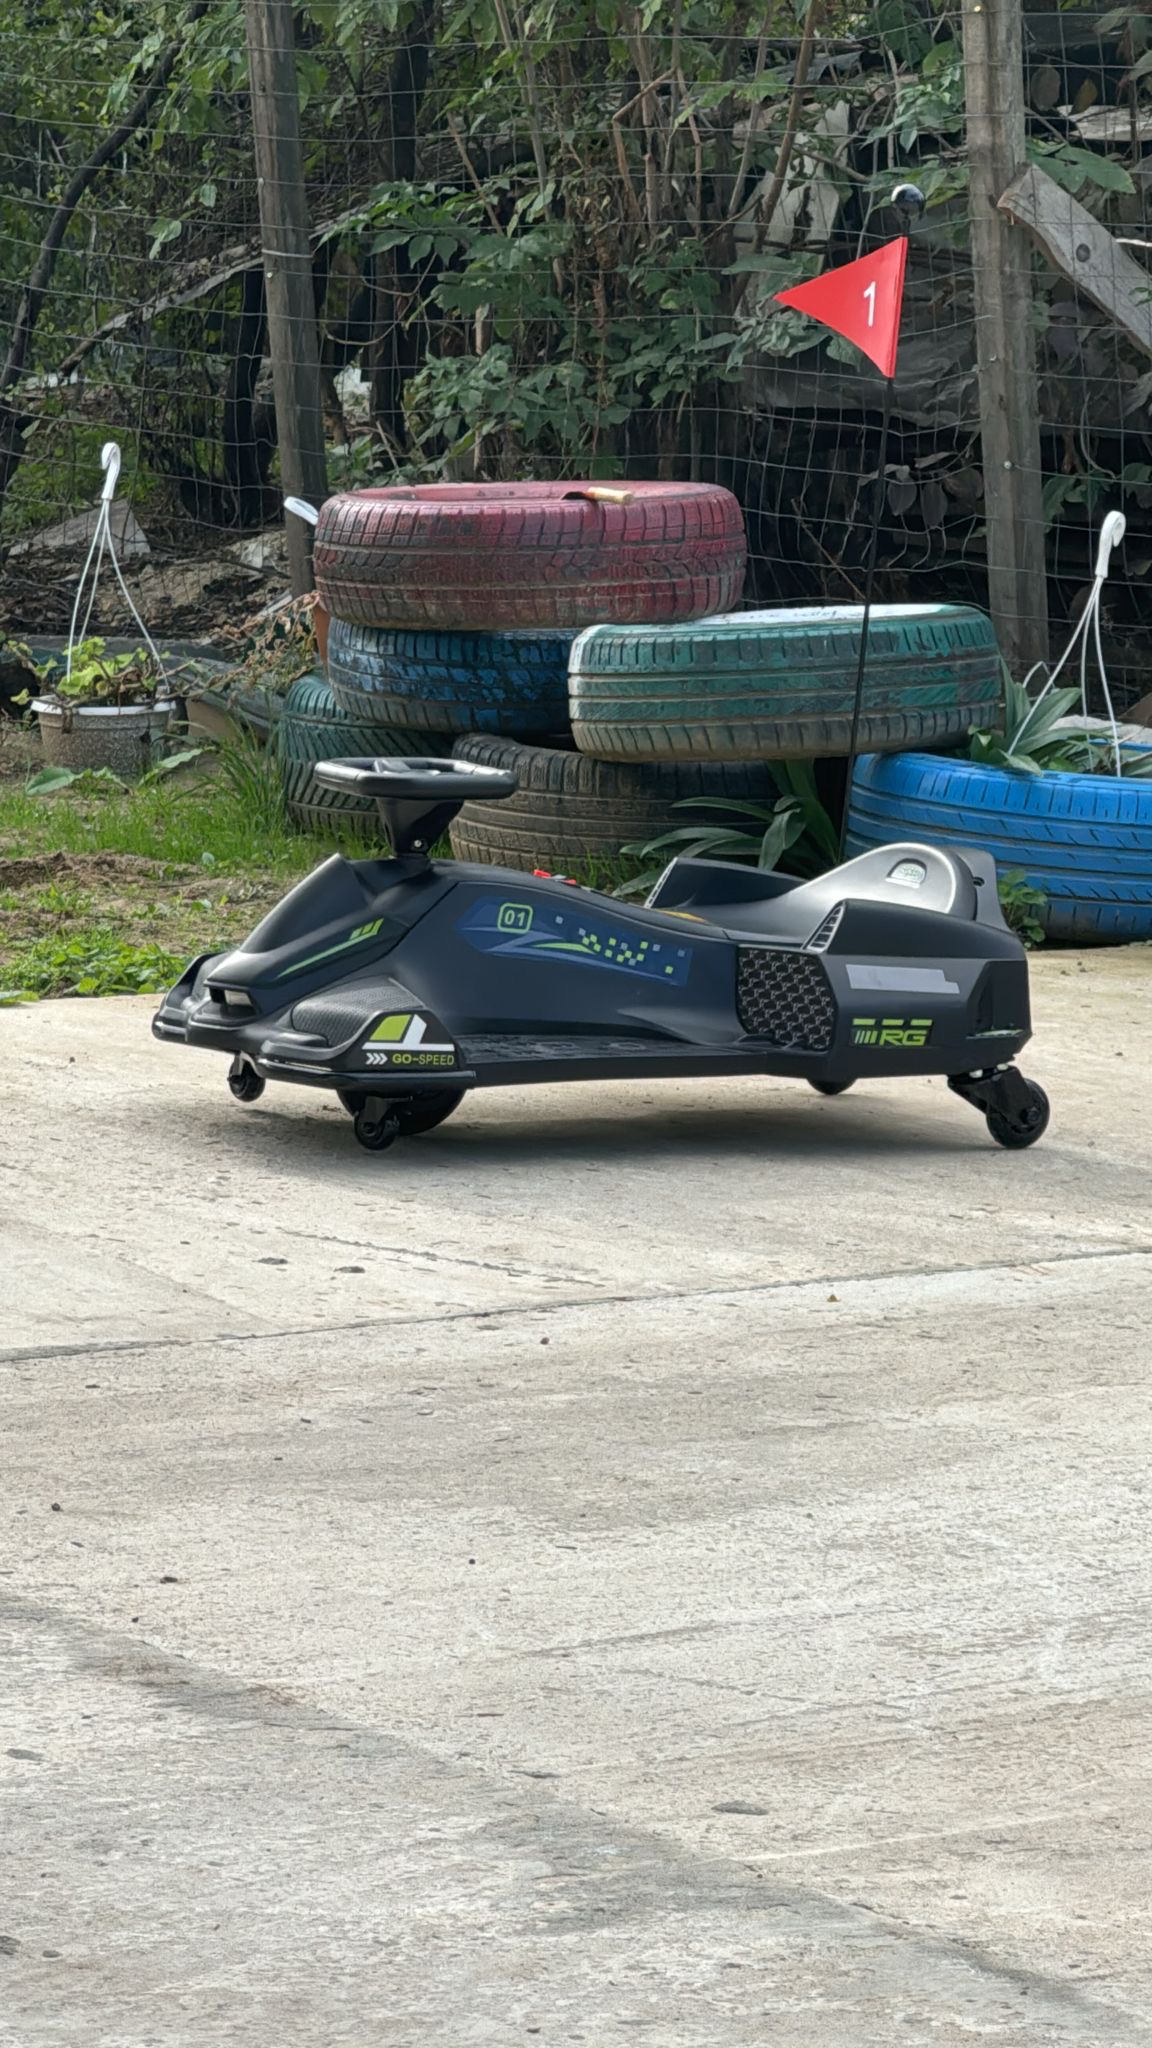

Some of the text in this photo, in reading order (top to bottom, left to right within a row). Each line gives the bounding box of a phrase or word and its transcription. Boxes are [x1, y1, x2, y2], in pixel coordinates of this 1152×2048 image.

[863, 281, 876, 327] 1
[504, 910, 525, 926] 01
[392, 1053, 455, 1066] GO-SPEED
